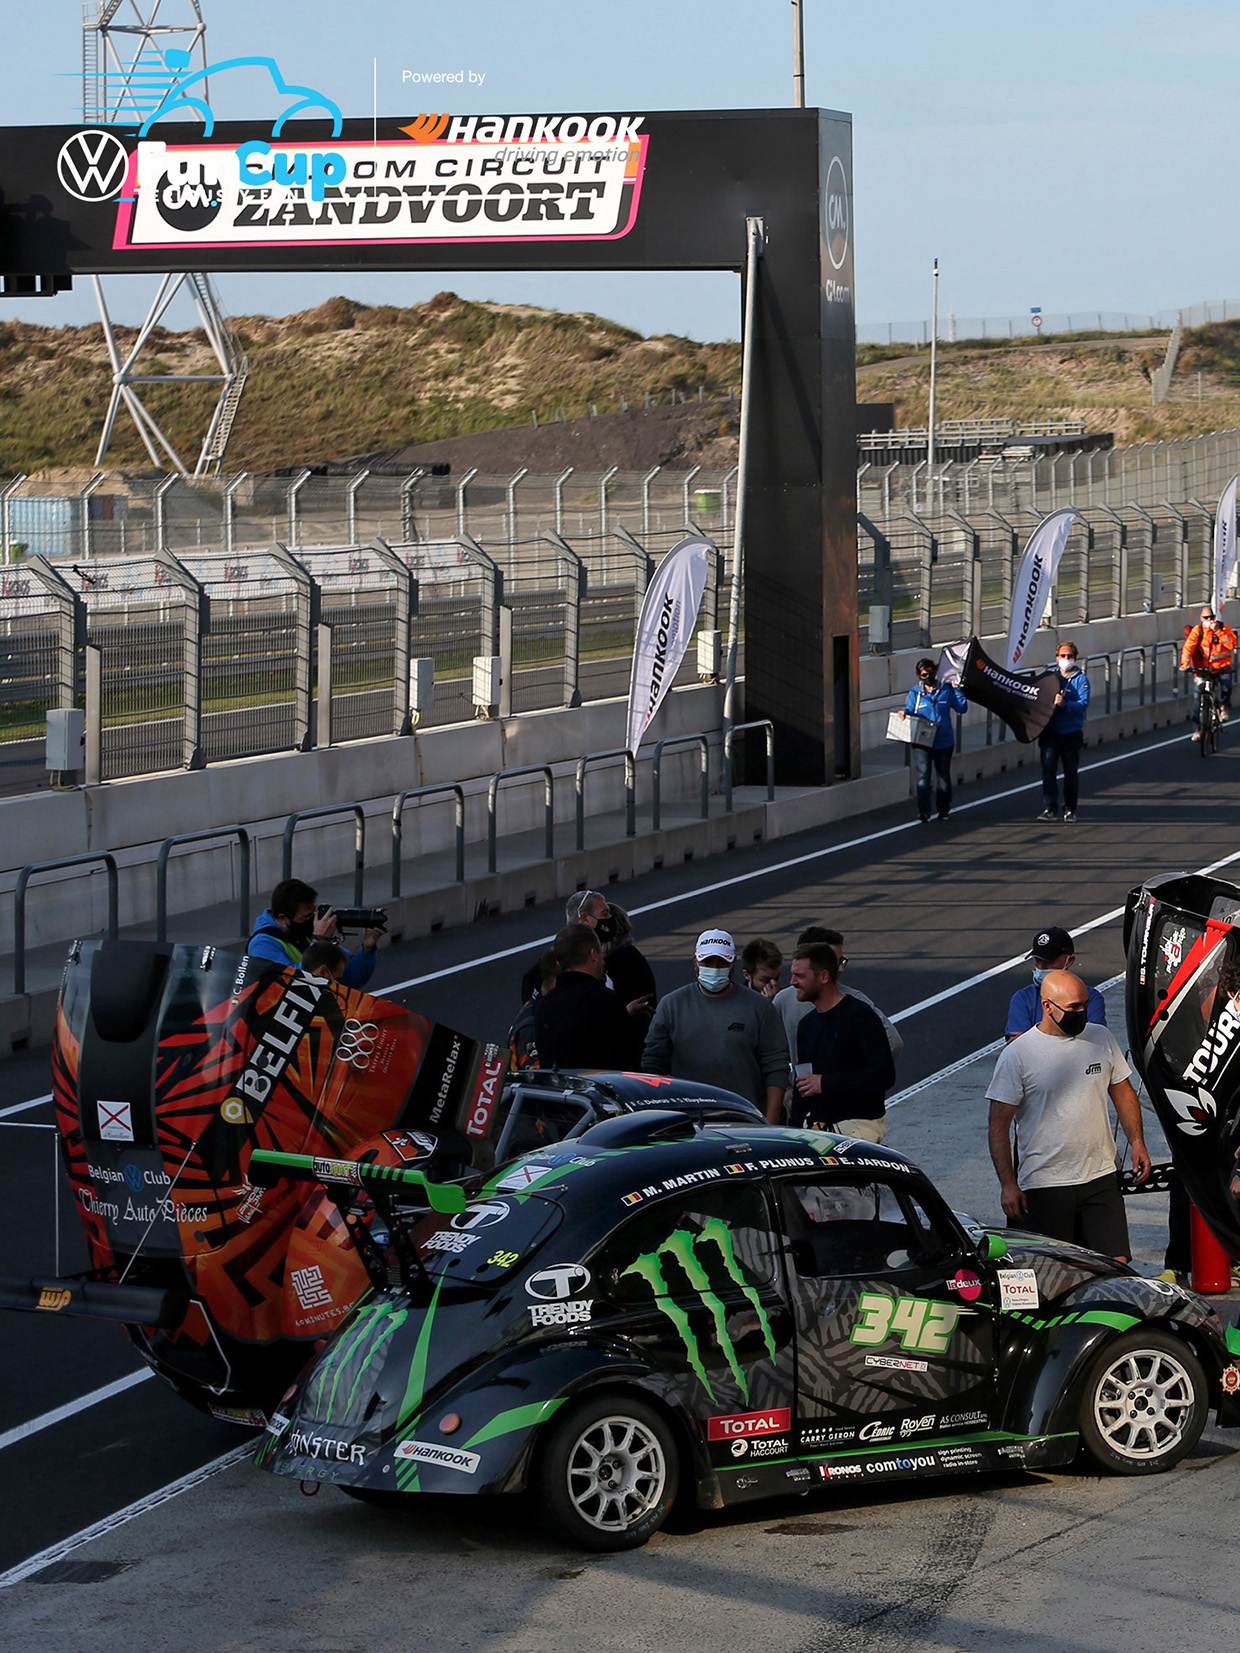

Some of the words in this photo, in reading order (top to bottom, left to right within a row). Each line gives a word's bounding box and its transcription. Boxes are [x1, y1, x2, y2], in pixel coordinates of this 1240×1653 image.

[435, 156, 611, 177] CIRCUIT
[232, 181, 606, 227] ZANDVOORT
[235, 955, 249, 985] Bollen
[236, 970, 330, 1103] BELFIX
[429, 1041, 462, 1124] MetaRelax
[467, 1062, 502, 1136] TOTAL
[87, 1164, 125, 1185] Belgian
[143, 1166, 172, 1186] Club
[642, 1185, 660, 1198] M.
[661, 1167, 721, 1189] MARTIN
[743, 1161, 758, 1171] F.
[758, 1156, 815, 1170] PLUNUS
[839, 1157, 854, 1165] E.
[856, 1157, 910, 1174] JARDON
[124, 1200, 157, 1223] Auto
[157, 1199, 208, 1224] Pièces
[420, 1238, 472, 1253] FOODS
[431, 1230, 481, 1245] TRENDY
[487, 1250, 519, 1269] 342
[1003, 1284, 1036, 1294] TOTAL
[527, 1299, 595, 1317] TRENDY
[531, 1310, 592, 1327] FOODS
[851, 1293, 959, 1351] 342
[865, 1356, 918, 1371] CYBERNET
[720, 1416, 780, 1434] TOTAL
[939, 1415, 950, 1424] AS
[950, 1411, 982, 1423] CONSULT
[751, 1438, 789, 1450] TOTAL
[800, 1435, 826, 1443] CARRY
[828, 1431, 855, 1440] GERON
[750, 1446, 789, 1457] HACCOURT
[940, 1454, 964, 1462] dynamic
[950, 1446, 972, 1455] printing
[280, 1462, 340, 1480] ENERGY
[818, 1463, 863, 1478] KRONOS
[866, 1455, 936, 1474] comtoyou
